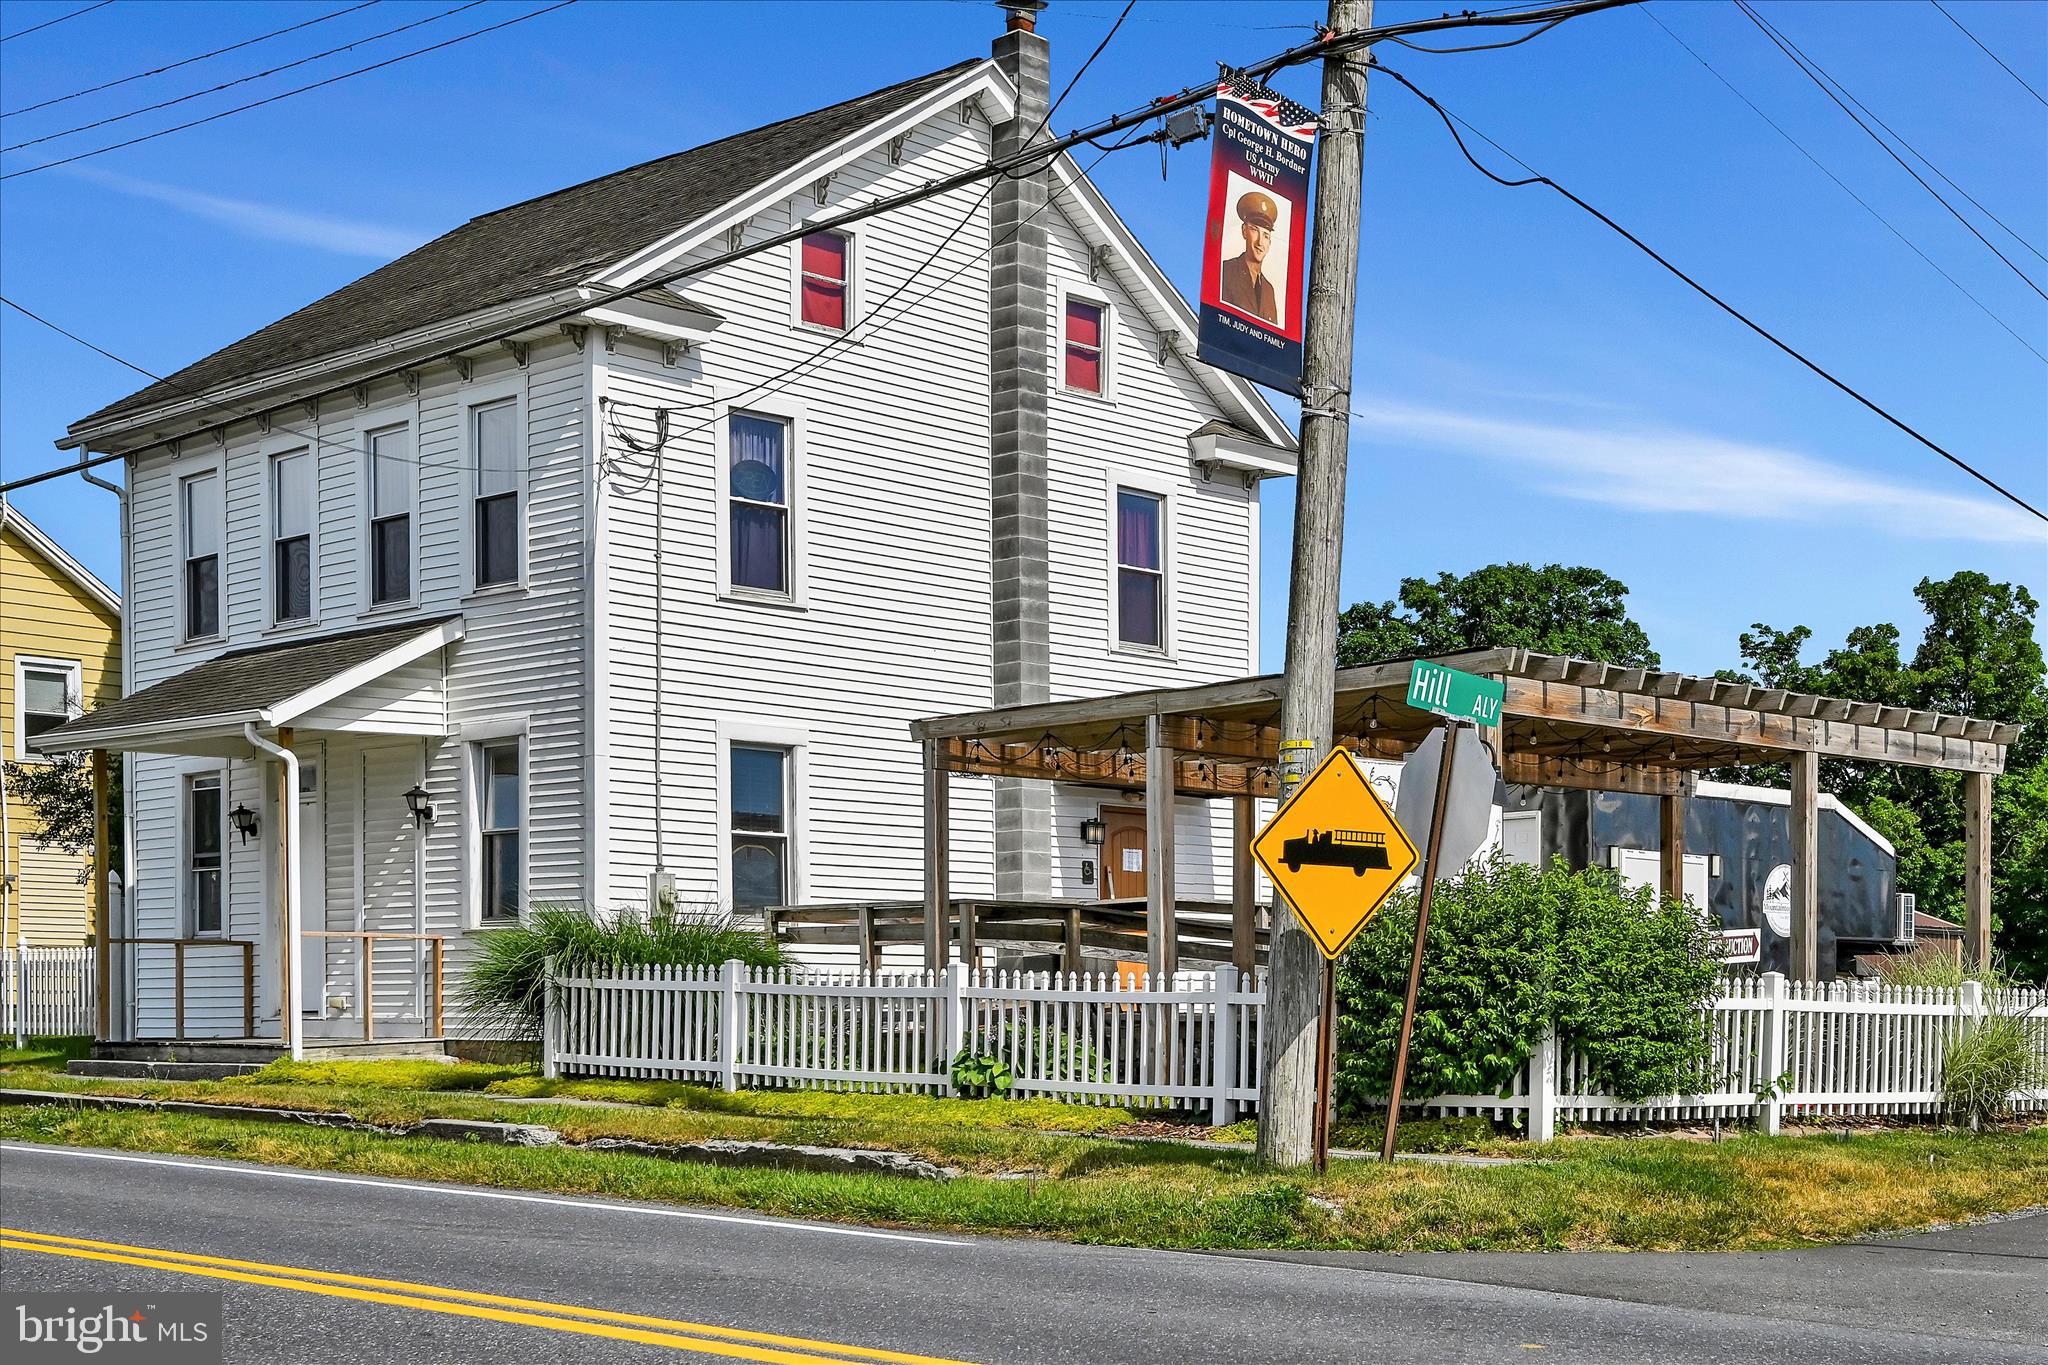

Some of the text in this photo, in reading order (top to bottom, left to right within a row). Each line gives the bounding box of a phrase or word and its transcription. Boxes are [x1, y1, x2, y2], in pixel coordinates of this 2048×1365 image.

[1222, 106, 1307, 160] HOMETOWN HERO
[1222, 123, 1306, 174] Cpl George H. Bordner
[1245, 150, 1280, 177] US Army
[1249, 165, 1274, 186] WWII
[1218, 314, 1286, 350] TIM, JUDY AND FAMILY
[1412, 667, 1499, 719] Hill ALY
